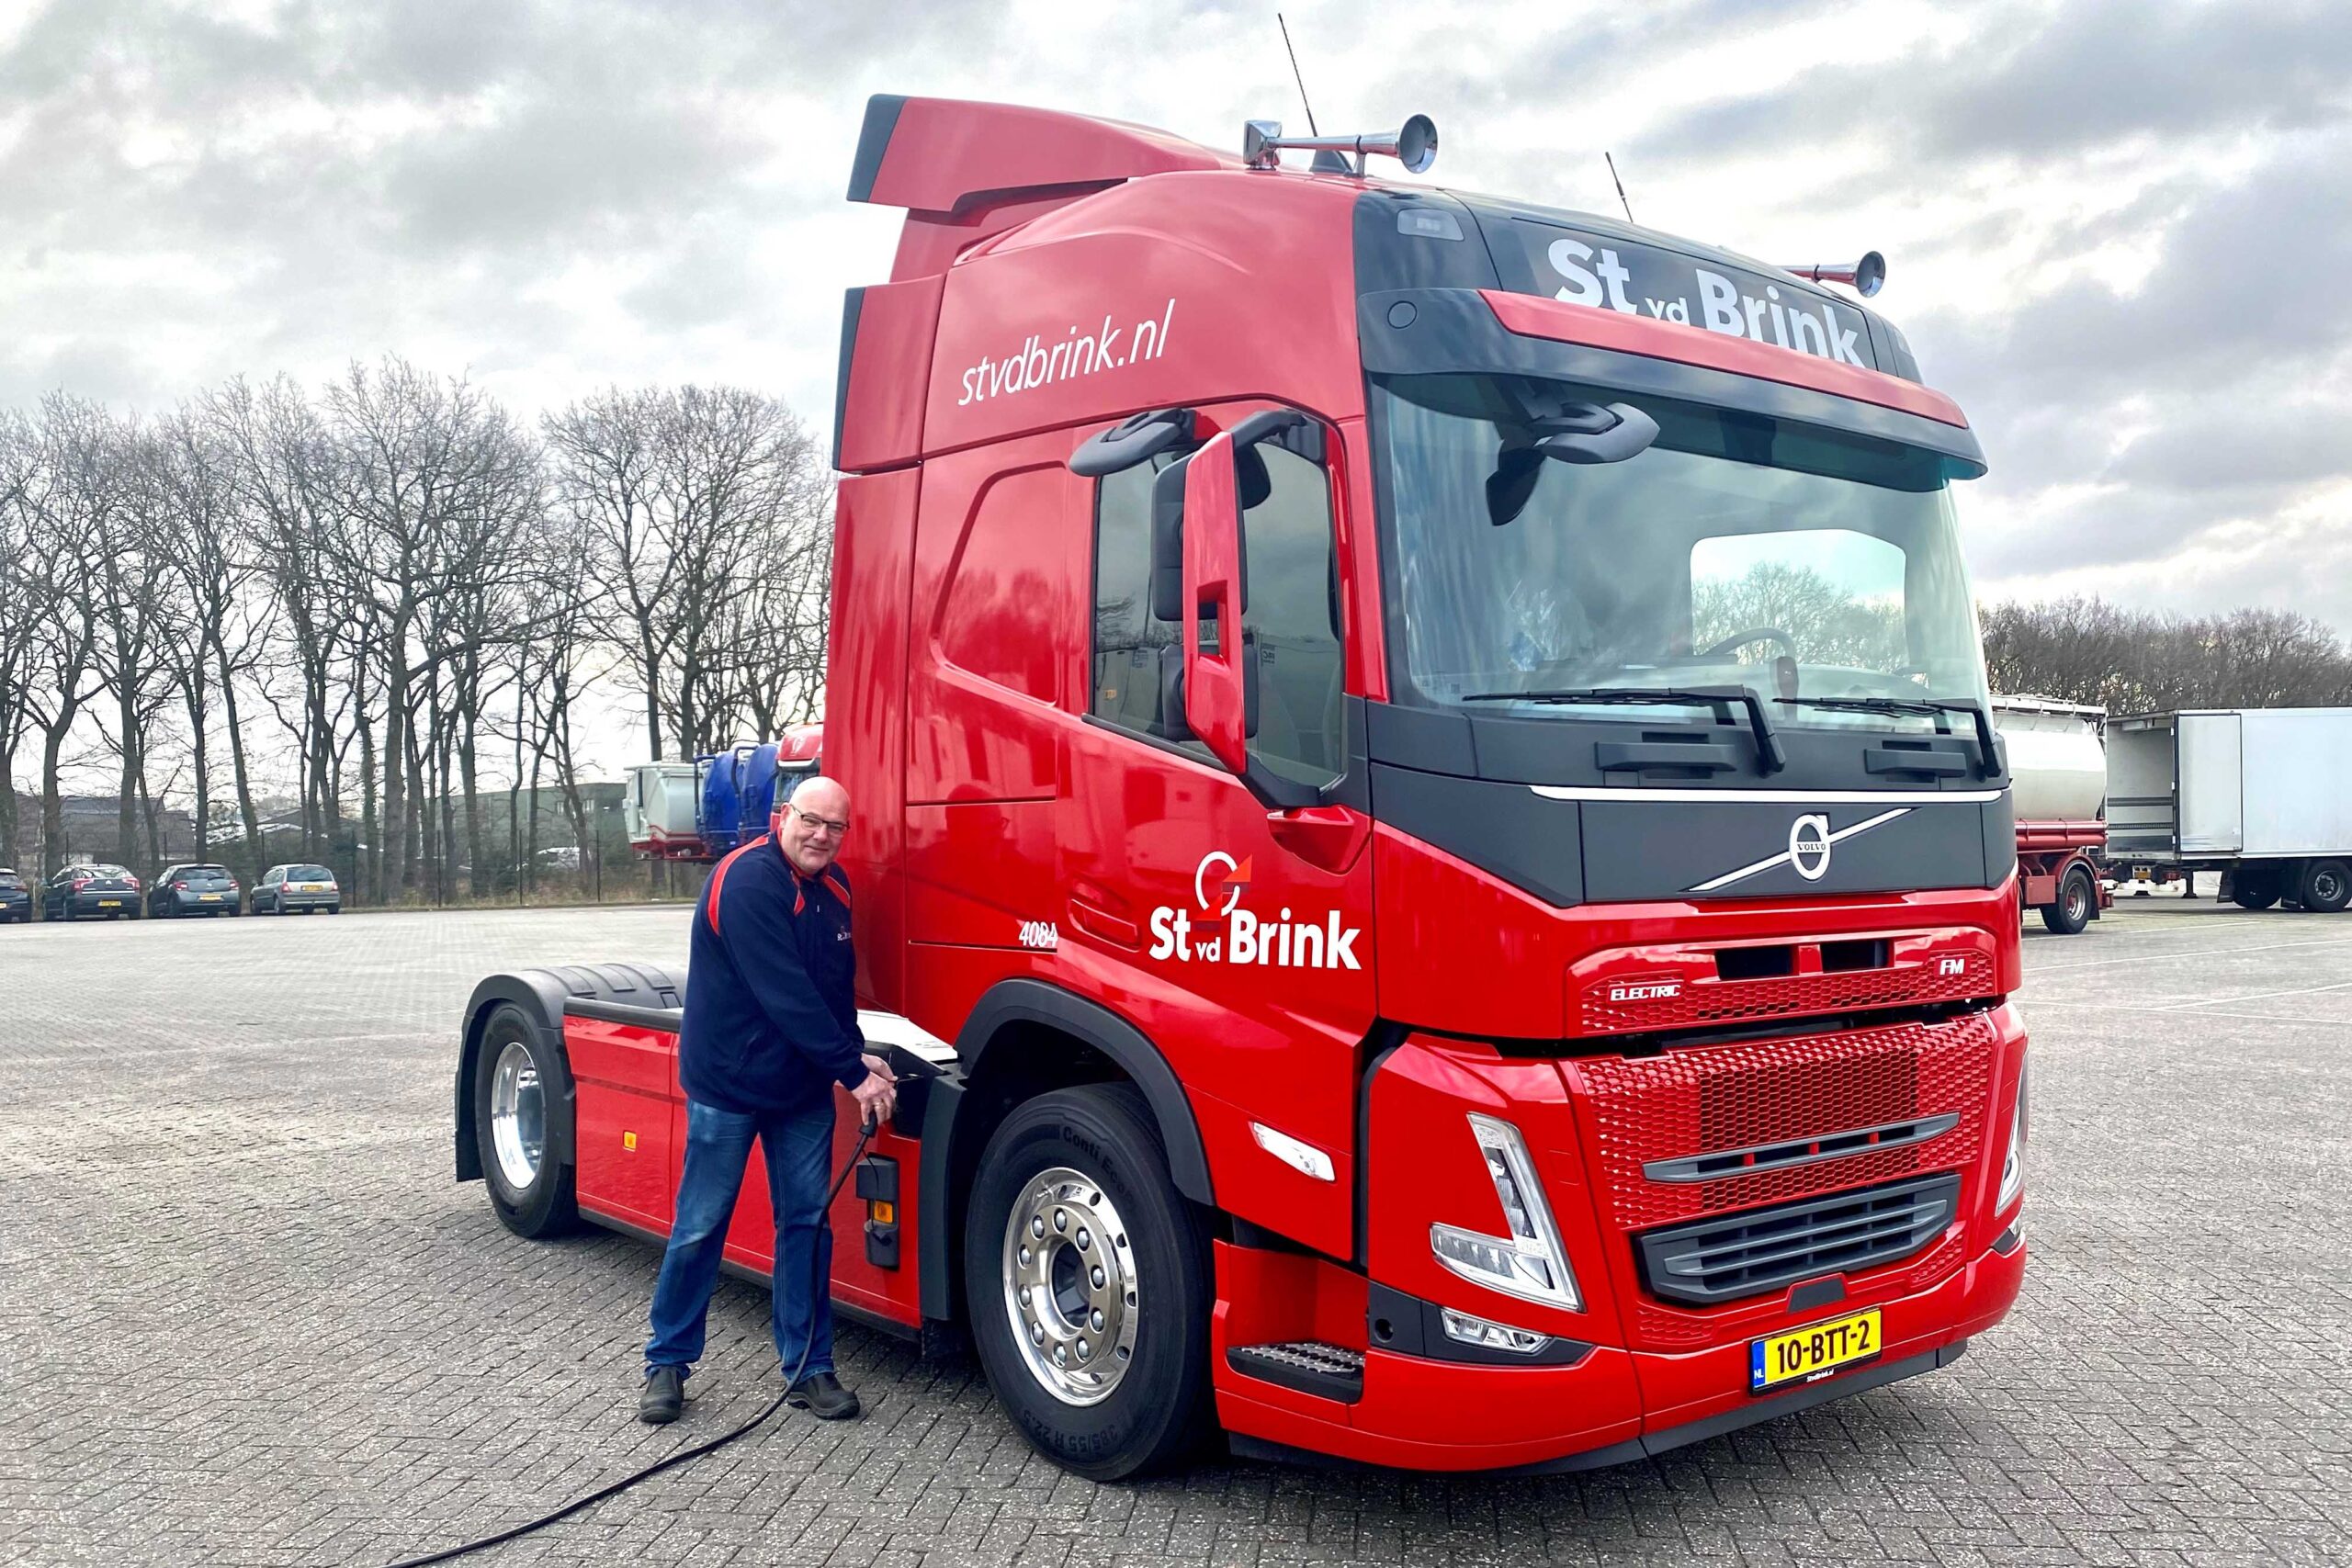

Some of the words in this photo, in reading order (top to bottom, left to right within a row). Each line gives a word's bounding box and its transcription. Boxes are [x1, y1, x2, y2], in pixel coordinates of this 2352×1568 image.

[1547, 239, 1637, 315] St
[1645, 298, 1690, 327] vd
[1695, 268, 1866, 367] Brink
[957, 298, 1175, 406] stvdbrink.nl
[1019, 920, 1058, 948] 4084
[1148, 906, 1192, 962] St
[1195, 937, 1221, 962] vd
[1229, 907, 1362, 970] Brink
[1939, 958, 1965, 975] FM
[1611, 985, 1681, 1001] ELECTRIC
[1777, 1319, 1870, 1373] 10-BTT-2
[1754, 1369, 1764, 1379] NL
